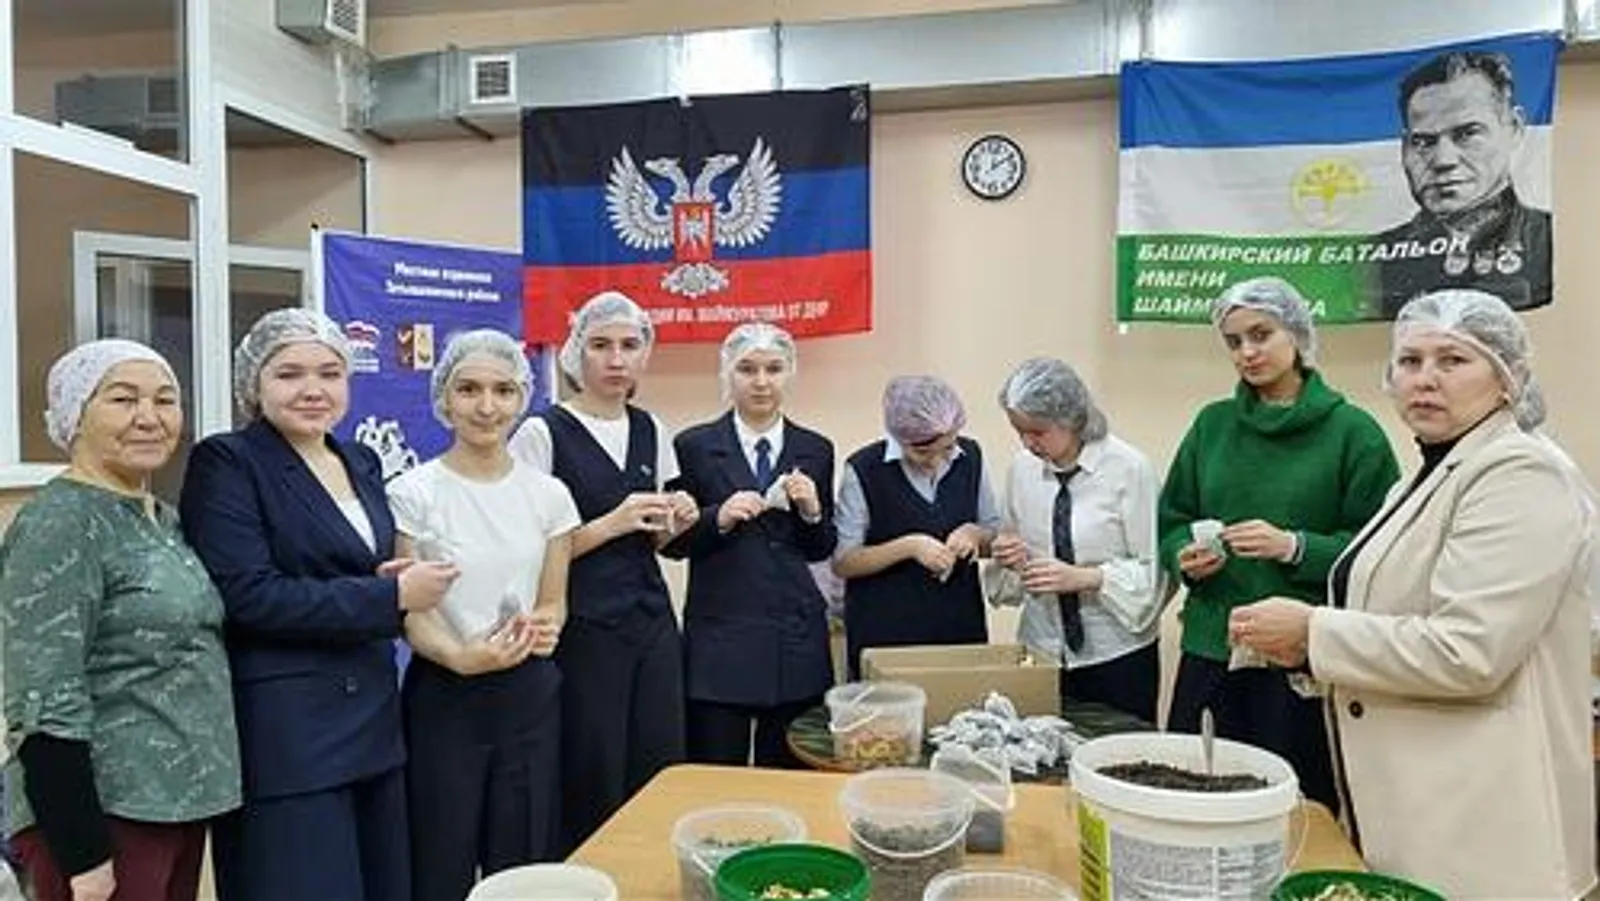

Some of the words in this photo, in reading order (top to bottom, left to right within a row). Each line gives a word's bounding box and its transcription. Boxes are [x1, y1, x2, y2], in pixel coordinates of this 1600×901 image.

[1137, 242, 1312, 265] БАШКИРСКИЙ
[1318, 233, 1470, 265] БАТАЛЬОН
[1135, 269, 1228, 288] ИМЕНИ
